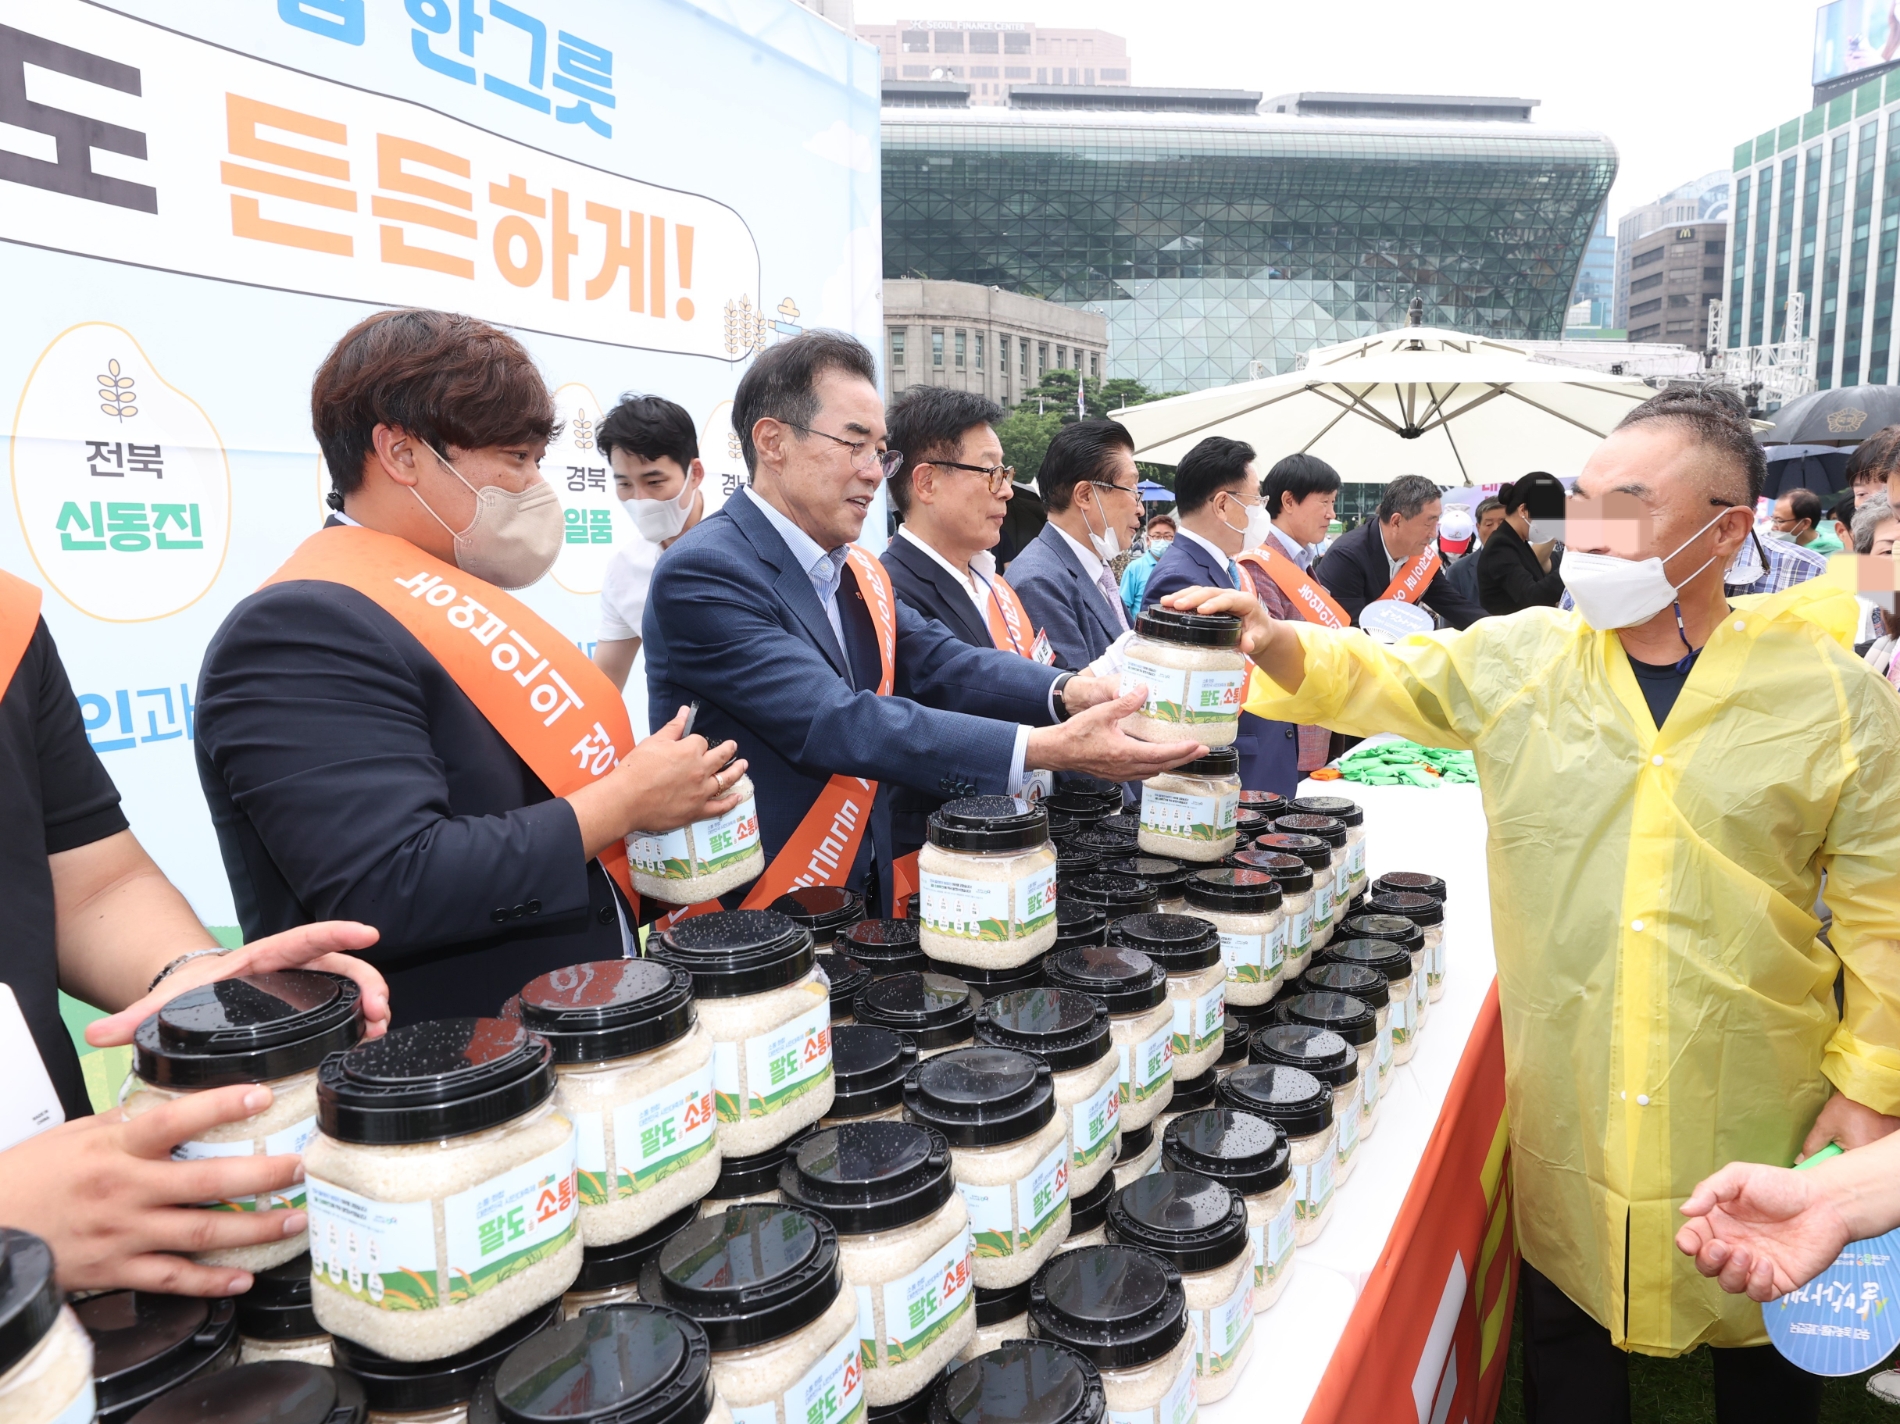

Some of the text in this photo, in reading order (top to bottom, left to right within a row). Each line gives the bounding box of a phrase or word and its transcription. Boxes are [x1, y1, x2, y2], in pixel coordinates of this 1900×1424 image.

[927, 21, 954, 30] SEOUL
[957, 21, 993, 30] FINANCE
[994, 22, 1025, 31] CENTER
[220, 91, 695, 322] 든든하게!
[84, 440, 165, 481] 전북
[566, 466, 606, 492] 경북
[55, 500, 203, 552] 신동진
[564, 508, 612, 544] 일품
[394, 571, 584, 727] 농업인의
[1200, 690, 1220, 707] 팔도
[709, 829, 733, 854] 팔도
[769, 1049, 798, 1086] 팔도
[641, 1116, 676, 1159] 팔도
[478, 1205, 525, 1257] 팔도
[908, 1287, 937, 1330] 팔도
